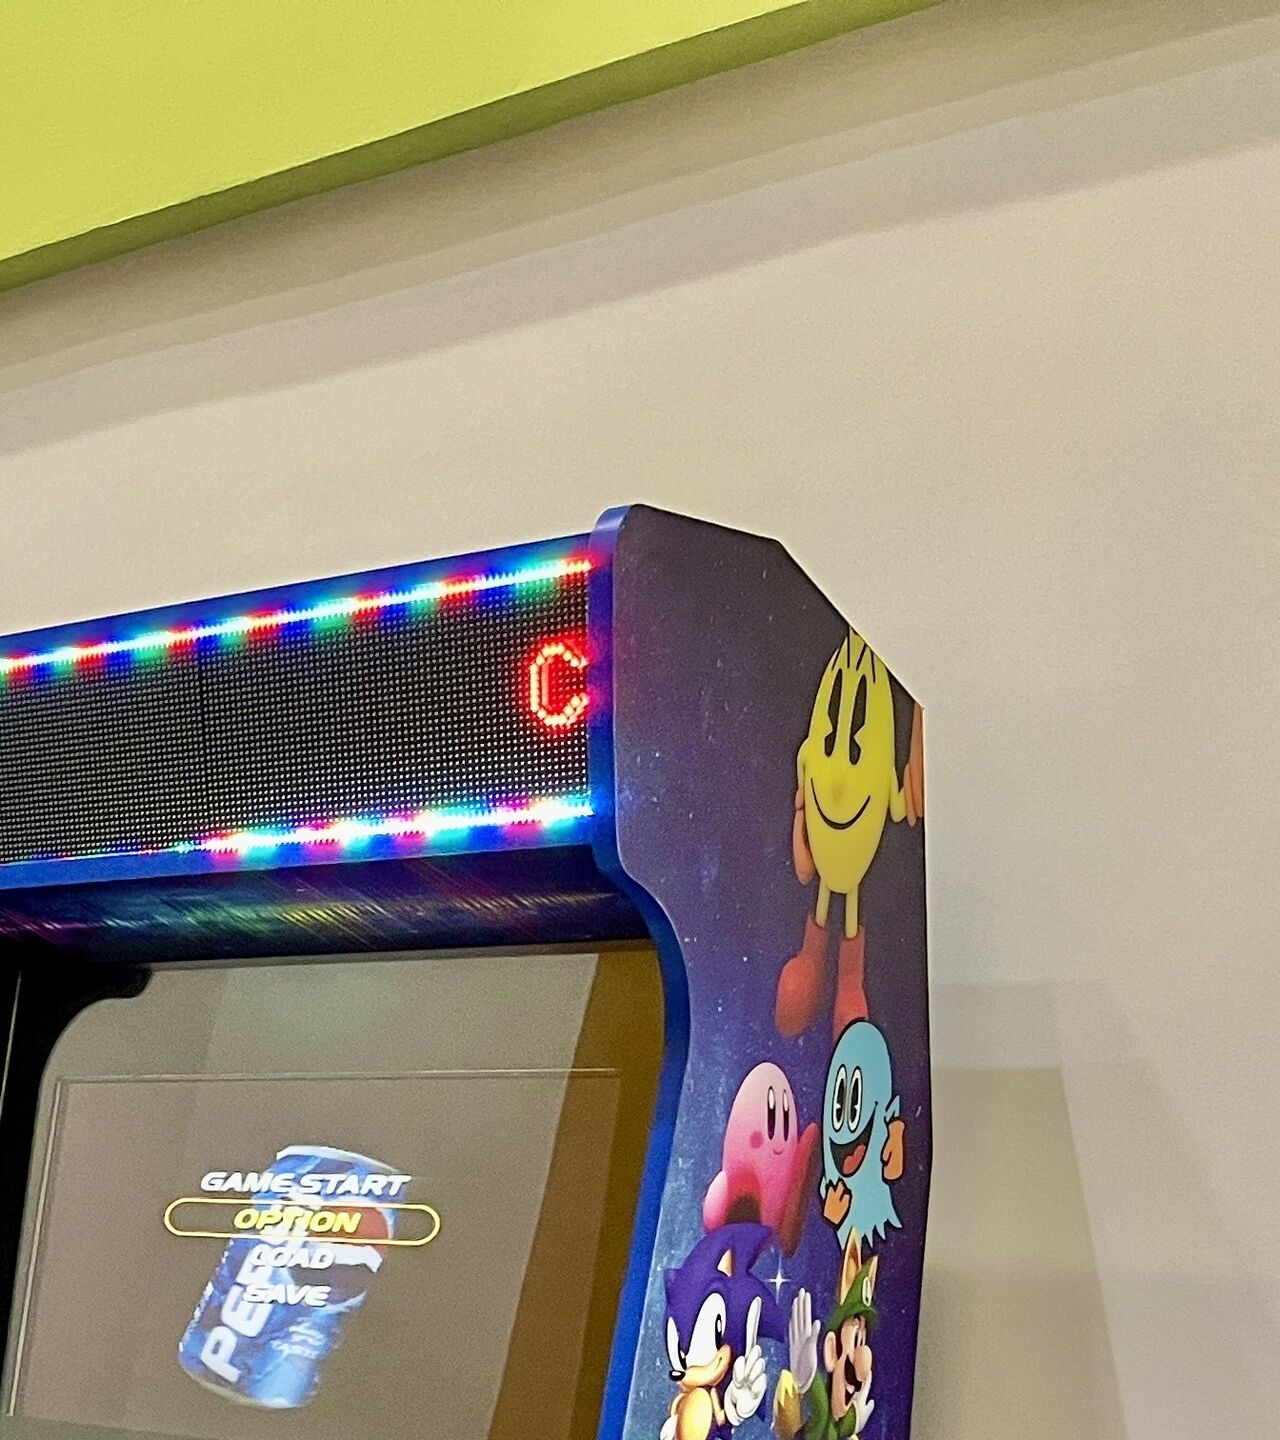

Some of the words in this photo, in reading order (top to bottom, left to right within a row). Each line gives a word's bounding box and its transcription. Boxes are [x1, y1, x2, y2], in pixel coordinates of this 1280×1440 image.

[529, 642, 589, 728] C
[200, 1171, 294, 1194] GAME
[298, 1173, 413, 1197] START
[232, 1207, 363, 1234] OPTION
[249, 1244, 337, 1270] LOAD
[242, 1284, 332, 1307] SAVE
